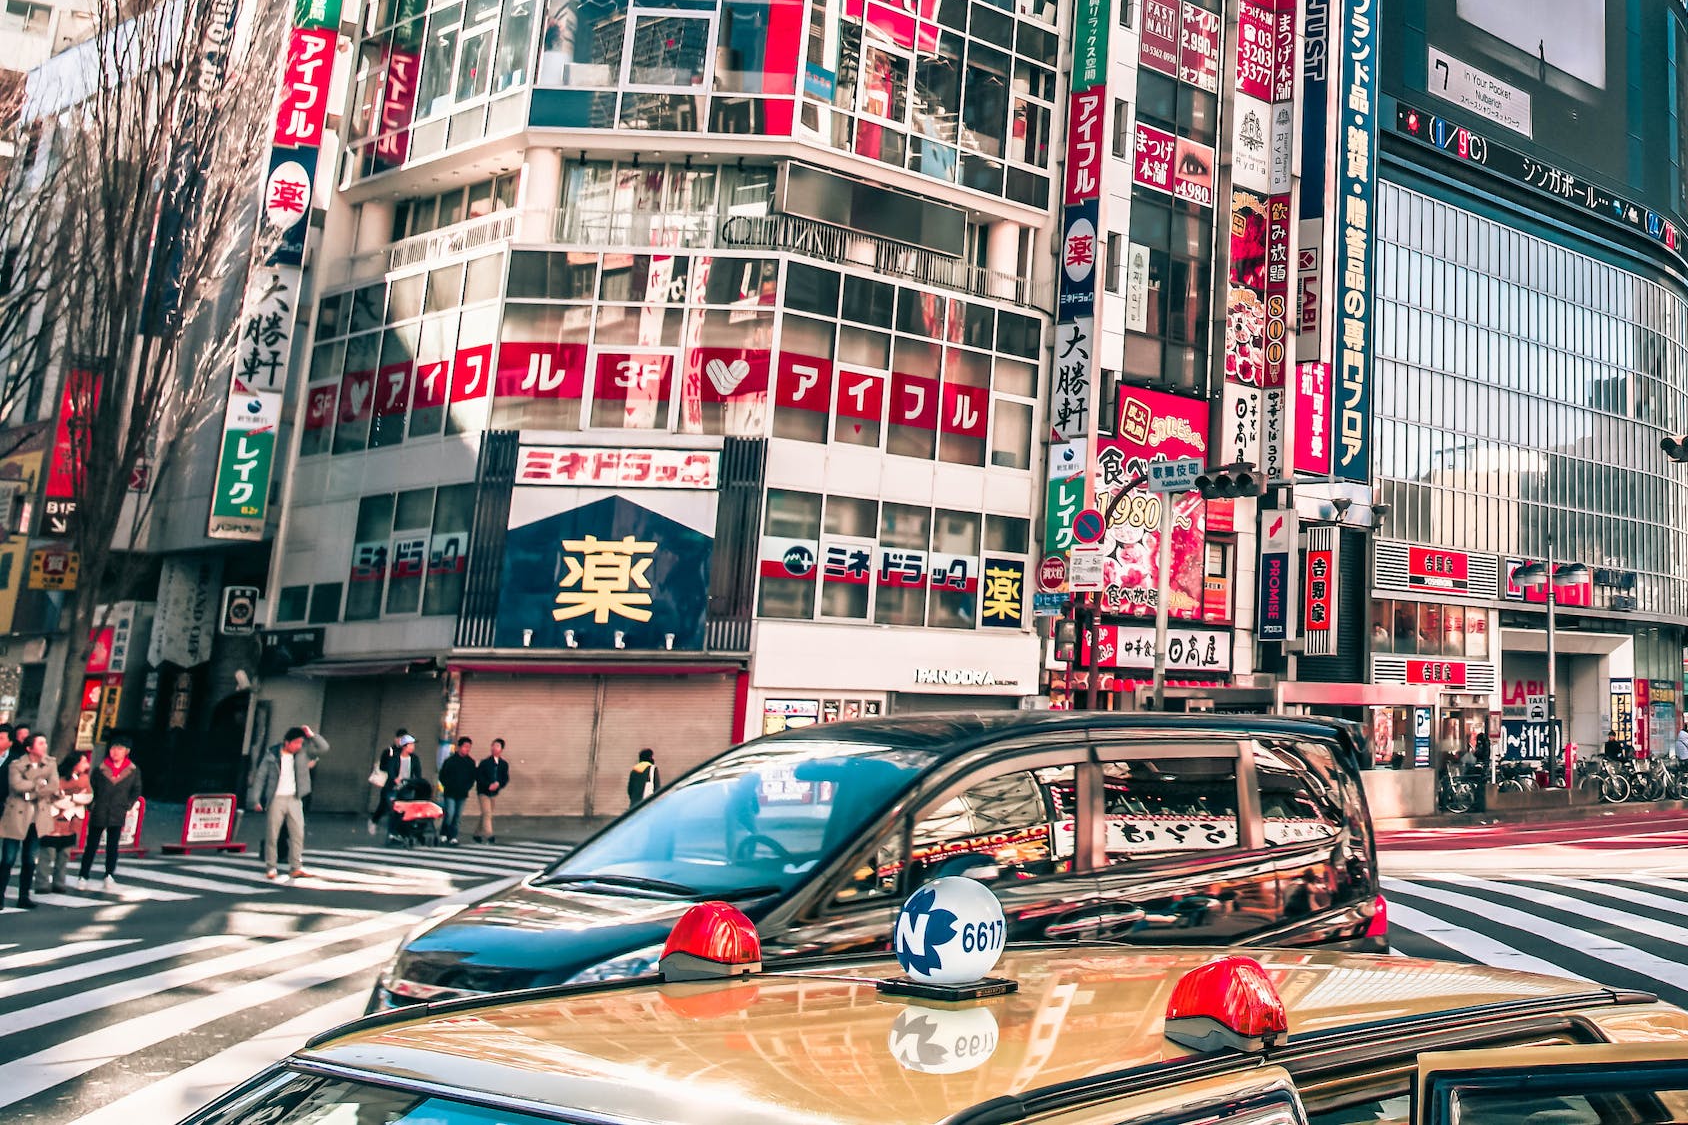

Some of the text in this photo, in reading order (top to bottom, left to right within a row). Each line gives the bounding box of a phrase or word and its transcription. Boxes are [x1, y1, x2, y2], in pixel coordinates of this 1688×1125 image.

[1146, 17, 1174, 42] NAIL
[1147, 0, 1174, 26] FAST
[1183, 4, 1218, 33] ネイル
[1239, 0, 1275, 27] まつげ本舗
[1257, 31, 1272, 49] 03
[1276, 13, 1293, 101] まつげ本舗
[284, 33, 319, 138] アイフル
[1434, 58, 1450, 91] 7
[1472, 71, 1512, 102] Your Pocket
[1073, 96, 1099, 195] アイフル
[1135, 129, 1173, 165] まつげ
[1274, 132, 1284, 185] Rydia
[1139, 155, 1167, 186] 本舗
[1236, 157, 1266, 176] Rydia
[273, 178, 306, 212] 薬
[1066, 235, 1093, 265] 薬
[1270, 202, 1287, 282] 飲み放題
[1302, 276, 1317, 332] LABI
[237, 273, 290, 386] 大勝軒
[1268, 294, 1285, 365] 800
[384, 353, 566, 411] アイフル
[614, 360, 661, 390] 3F
[1056, 325, 1089, 432] 大勝軒
[312, 393, 335, 414] 3F
[791, 361, 980, 431] アイフル
[228, 434, 261, 505] レイク
[1152, 462, 1199, 480] 歌舞伎町
[1161, 478, 1191, 487] Kabukicho
[45, 500, 77, 516] B1F
[1055, 485, 1077, 550] レイク
[552, 535, 658, 624] 薬
[983, 566, 1023, 621] 薬
[1269, 559, 1280, 620] PROMISE
[1311, 557, 1327, 623] 吉野家
[1168, 634, 1220, 666] 日高屋
[913, 666, 995, 687] PANDORA
[1528, 697, 1546, 705] TAXI
[960, 919, 1004, 954] 6617
